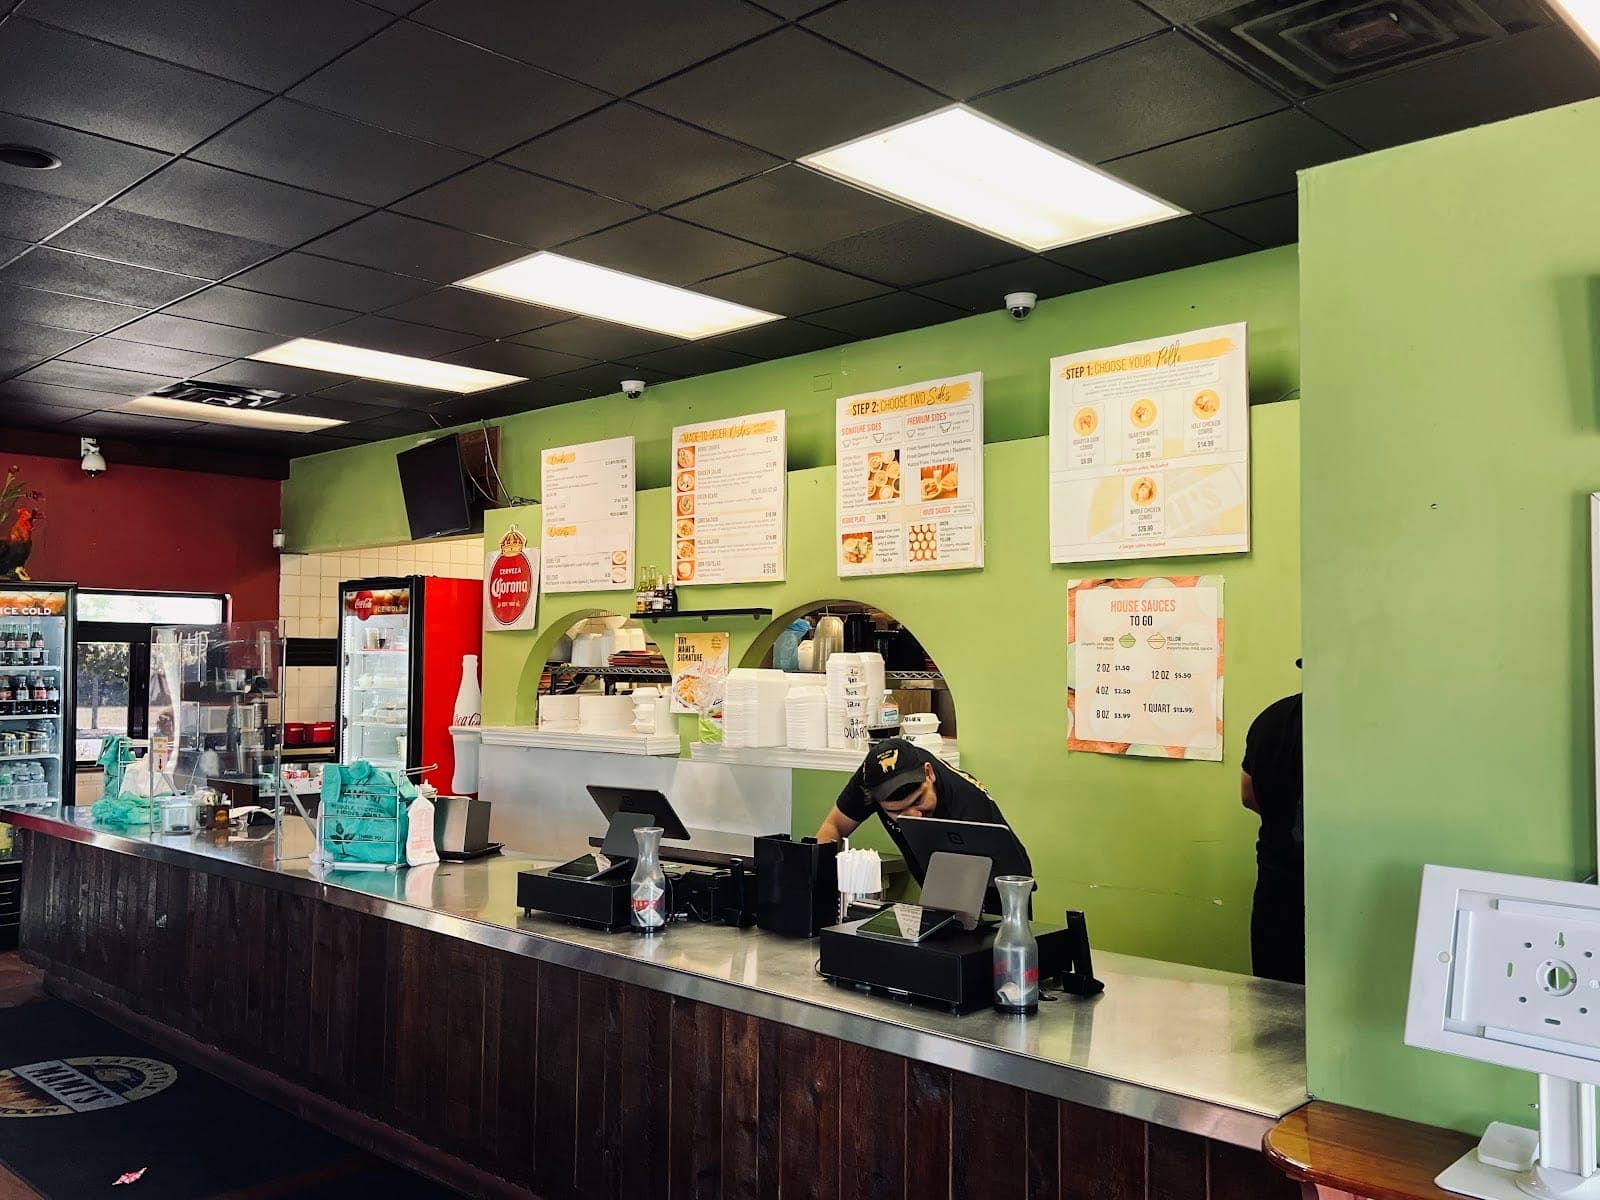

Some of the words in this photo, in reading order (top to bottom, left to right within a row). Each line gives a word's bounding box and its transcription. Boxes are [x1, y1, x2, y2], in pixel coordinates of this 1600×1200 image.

[1066, 366, 1085, 380] STEP
[1094, 359, 1126, 376] CHOOSE
[1130, 354, 1151, 369] YOUR
[852, 401, 870, 416] STEP
[880, 395, 908, 411] CHOOSE
[910, 391, 926, 406] TWO
[907, 414, 930, 425] PREMIUM
[931, 412, 947, 422] SIDES
[841, 425, 867, 436] SIGNATURE
[867, 422, 882, 433] SIDES
[499, 567, 521, 575] CERVEZA
[491, 577, 528, 599] Corona
[1111, 600, 1138, 612] HOUSE
[1141, 599, 1176, 612] SAUCES
[0, 607, 18, 615] ICE
[22, 607, 51, 615] COLD
[1130, 616, 1140, 626] TO
[1142, 616, 1153, 626] GO
[677, 653, 703, 661] SIGNATURE
[1097, 664, 1101, 672] 2
[1102, 664, 1110, 672] OZ
[1151, 671, 1159, 679] 12
[1161, 671, 1170, 679] OZ
[1096, 686, 1100, 694] 4
[1101, 686, 1109, 695] OZ
[1143, 703, 1147, 711] 1
[1149, 704, 1171, 713] QUART
[1096, 710, 1100, 719] 8
[1101, 710, 1110, 719] OZ
[24, 1065, 114, 1105] MAMI'S
